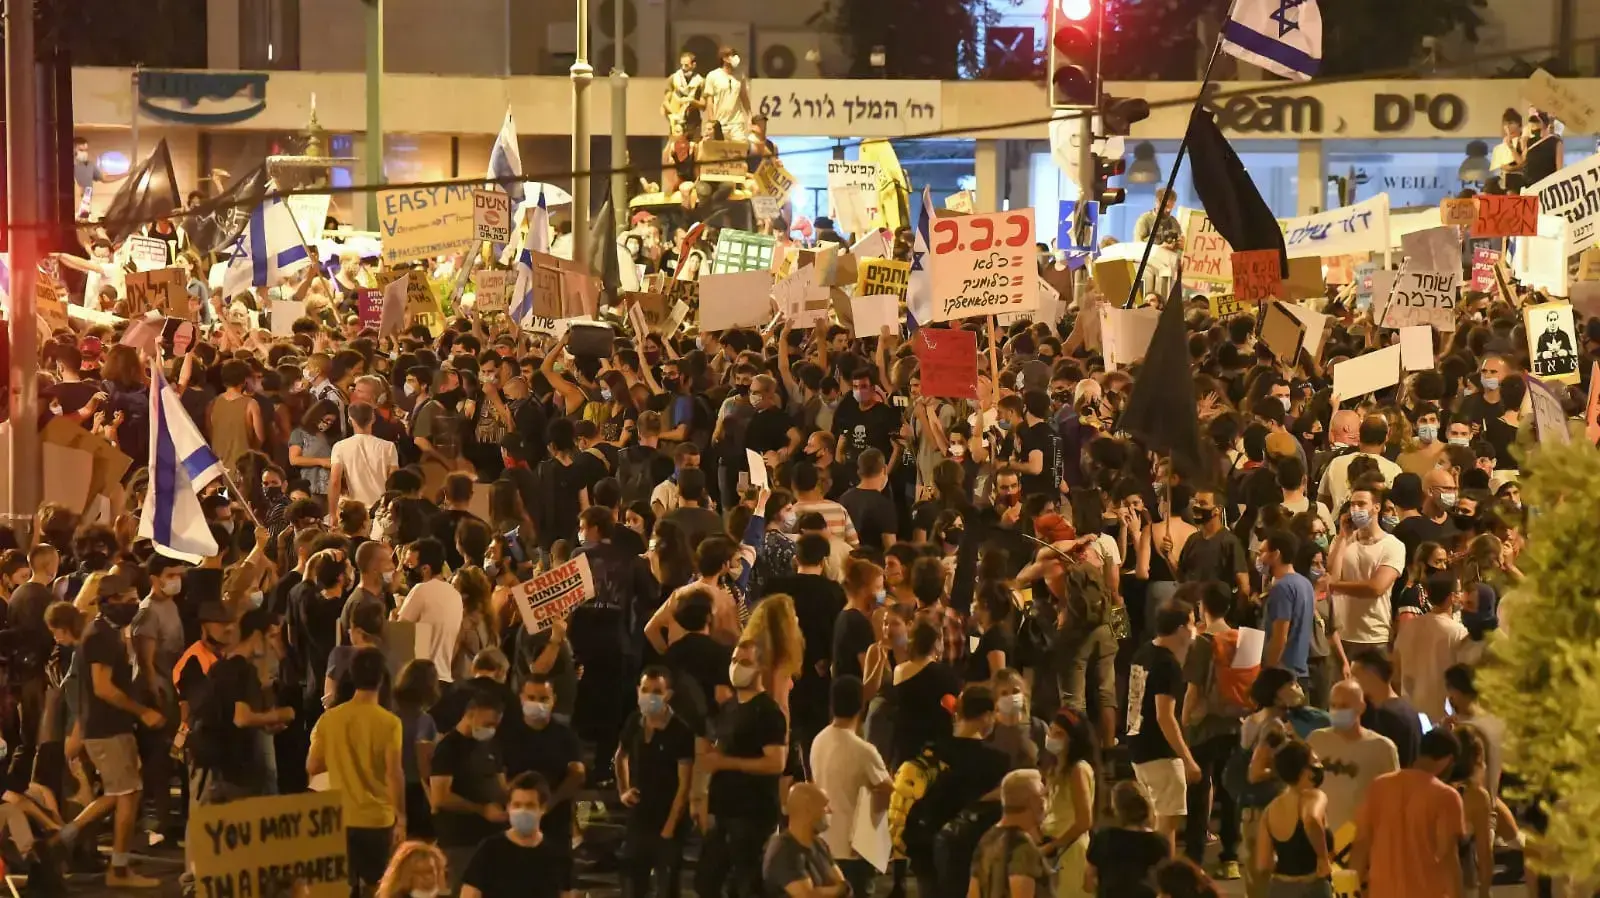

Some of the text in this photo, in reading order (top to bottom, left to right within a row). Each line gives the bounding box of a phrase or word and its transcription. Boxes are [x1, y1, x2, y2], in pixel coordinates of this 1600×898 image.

[759, 92, 935, 124] רח' המלך ג'ורג' 62
[1374, 92, 1465, 132] סים
[828, 162, 875, 177] קפיטליזם
[1384, 175, 1444, 190] WEILL
[475, 194, 508, 212] אשם
[1538, 174, 1587, 215] המתון
[1193, 235, 1226, 252] רצח
[973, 252, 1009, 271] כלא
[867, 264, 908, 285] ותקים
[963, 273, 1010, 293] כלומניק
[1411, 272, 1455, 292] שוחד
[1397, 290, 1454, 309] מרמה
[523, 560, 580, 595] CRIME
[527, 572, 582, 605] MINISTER
[533, 586, 585, 620] CRIME
[204, 804, 344, 856] YOU MAY SAY
[238, 869, 253, 898] A
